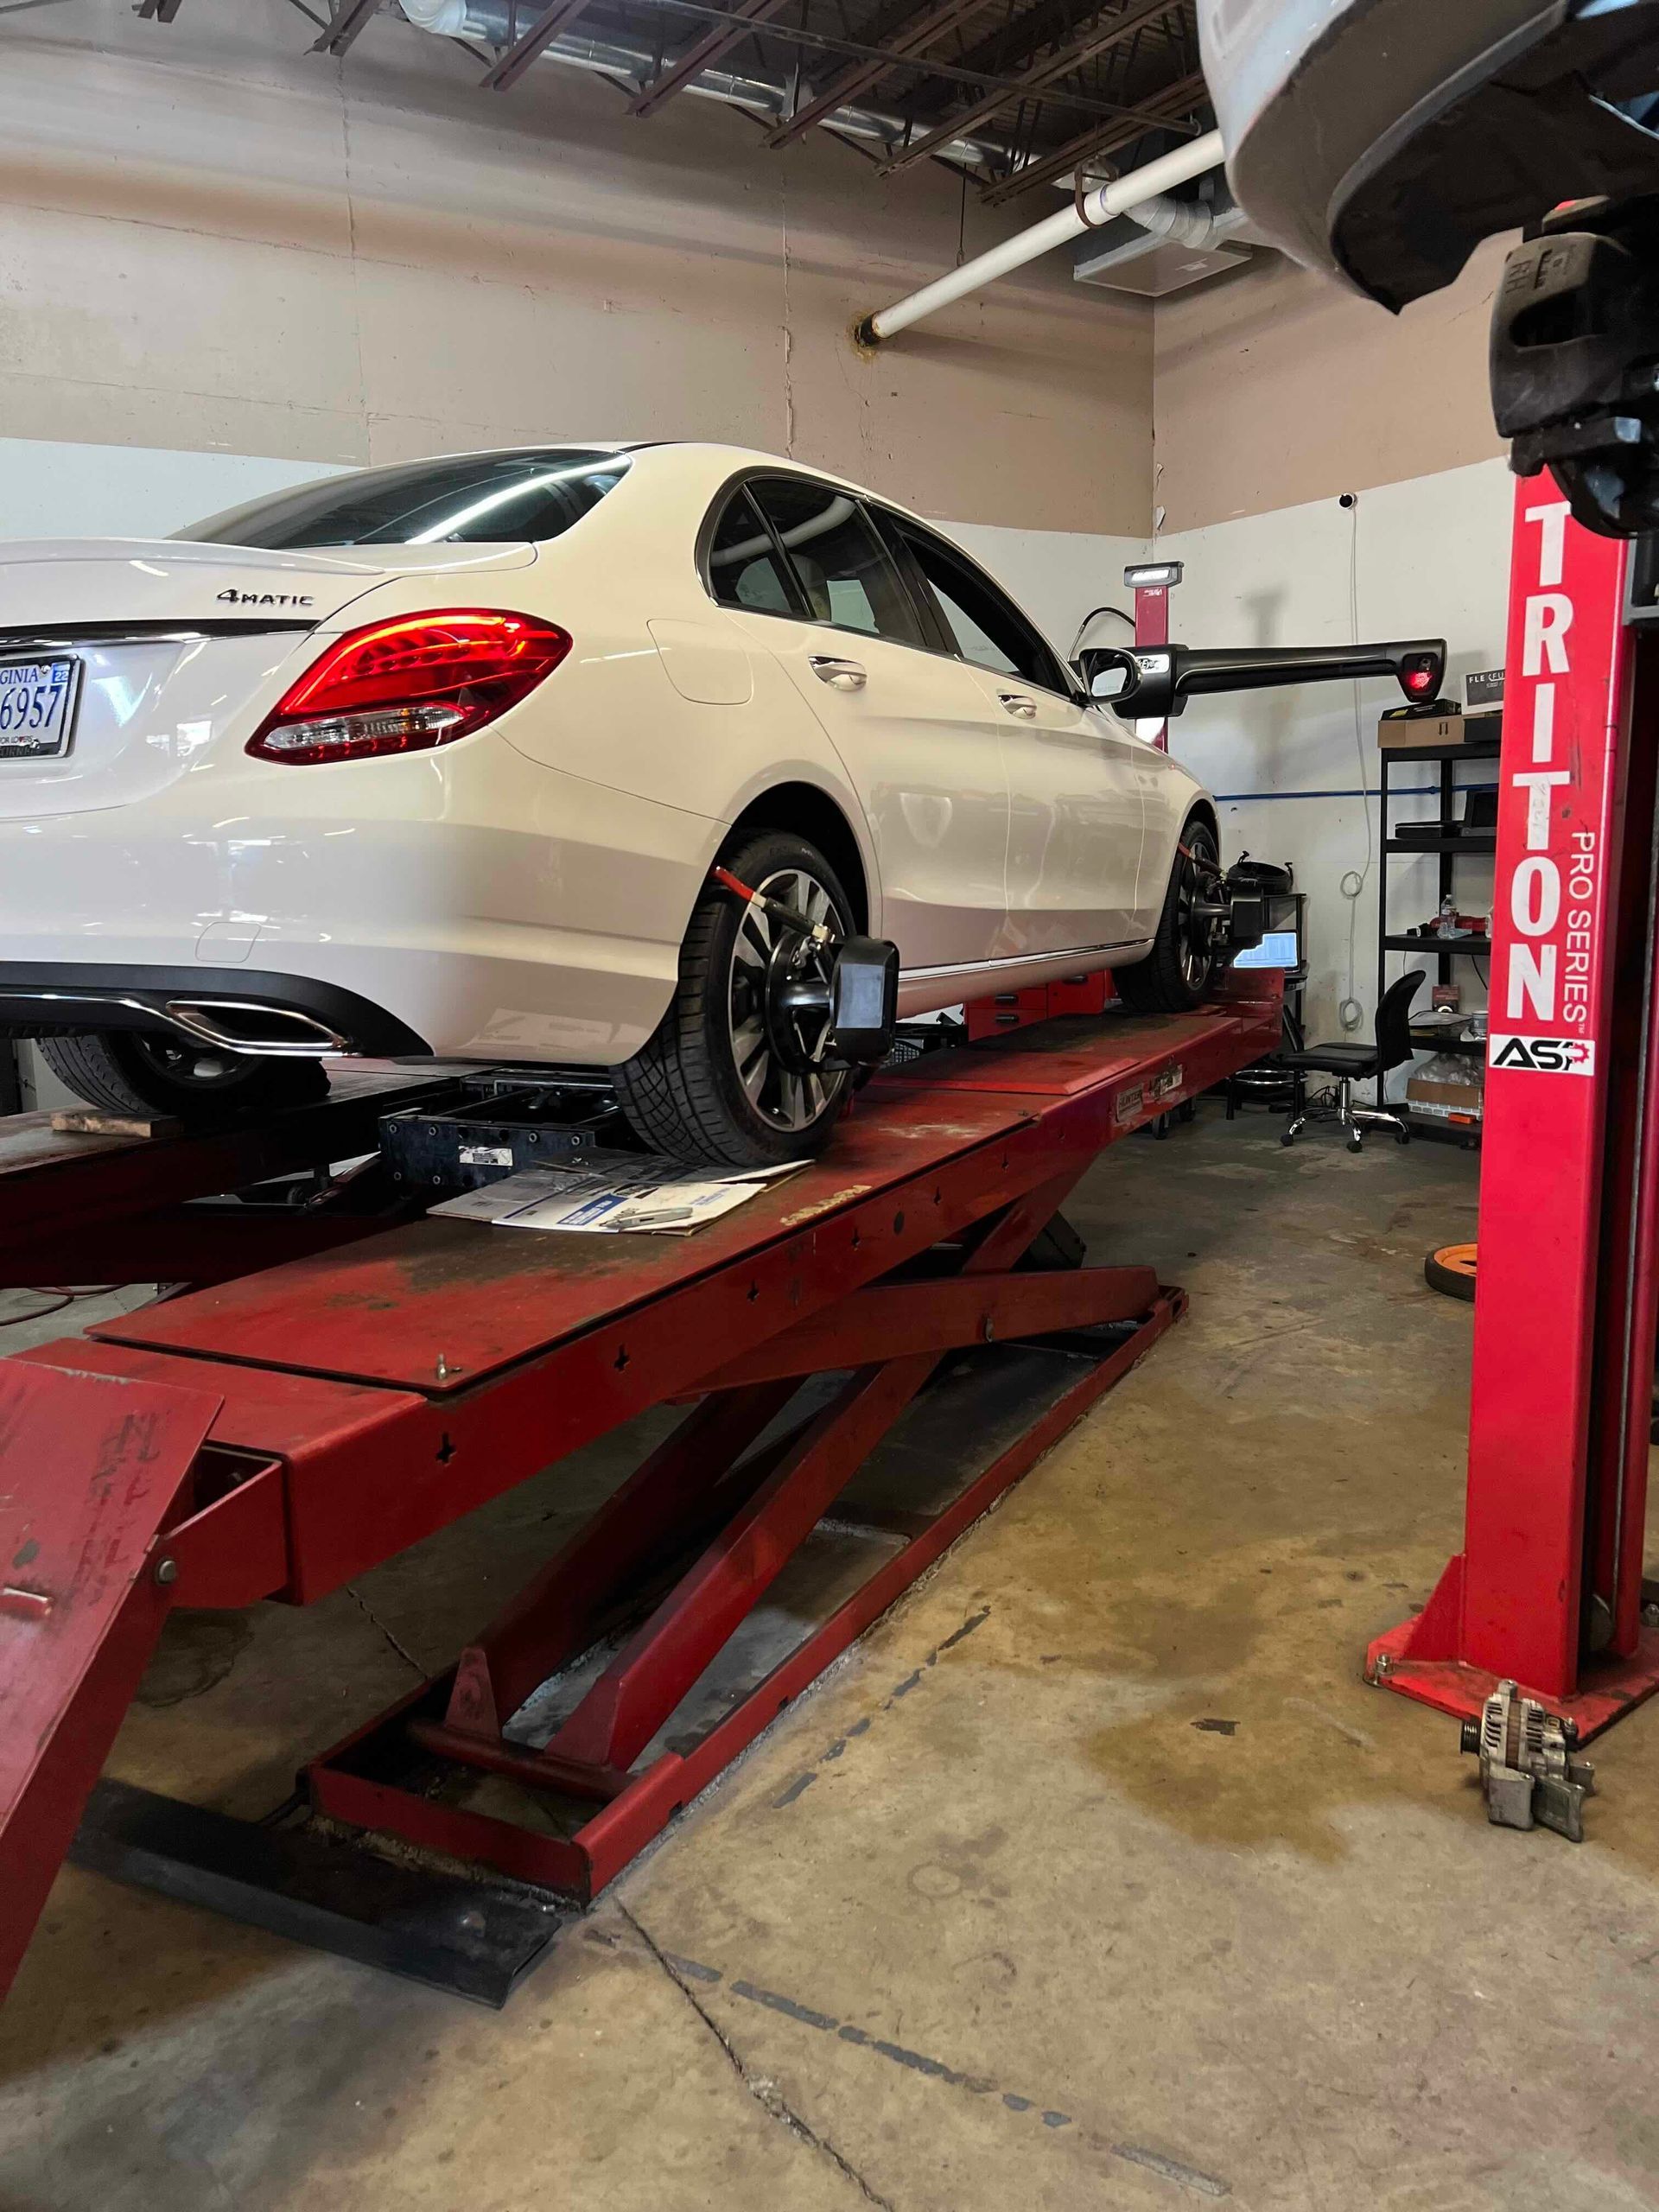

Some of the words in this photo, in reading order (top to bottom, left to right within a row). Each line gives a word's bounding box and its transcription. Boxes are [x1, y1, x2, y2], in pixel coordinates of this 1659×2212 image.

[216, 588, 315, 607] 4MATIC
[54, 671, 68, 682] 22
[0, 685, 63, 729] 6957
[1506, 499, 1574, 1022] TRITON
[1568, 831, 1596, 900] PRO
[1562, 909, 1592, 1023] SERIES
